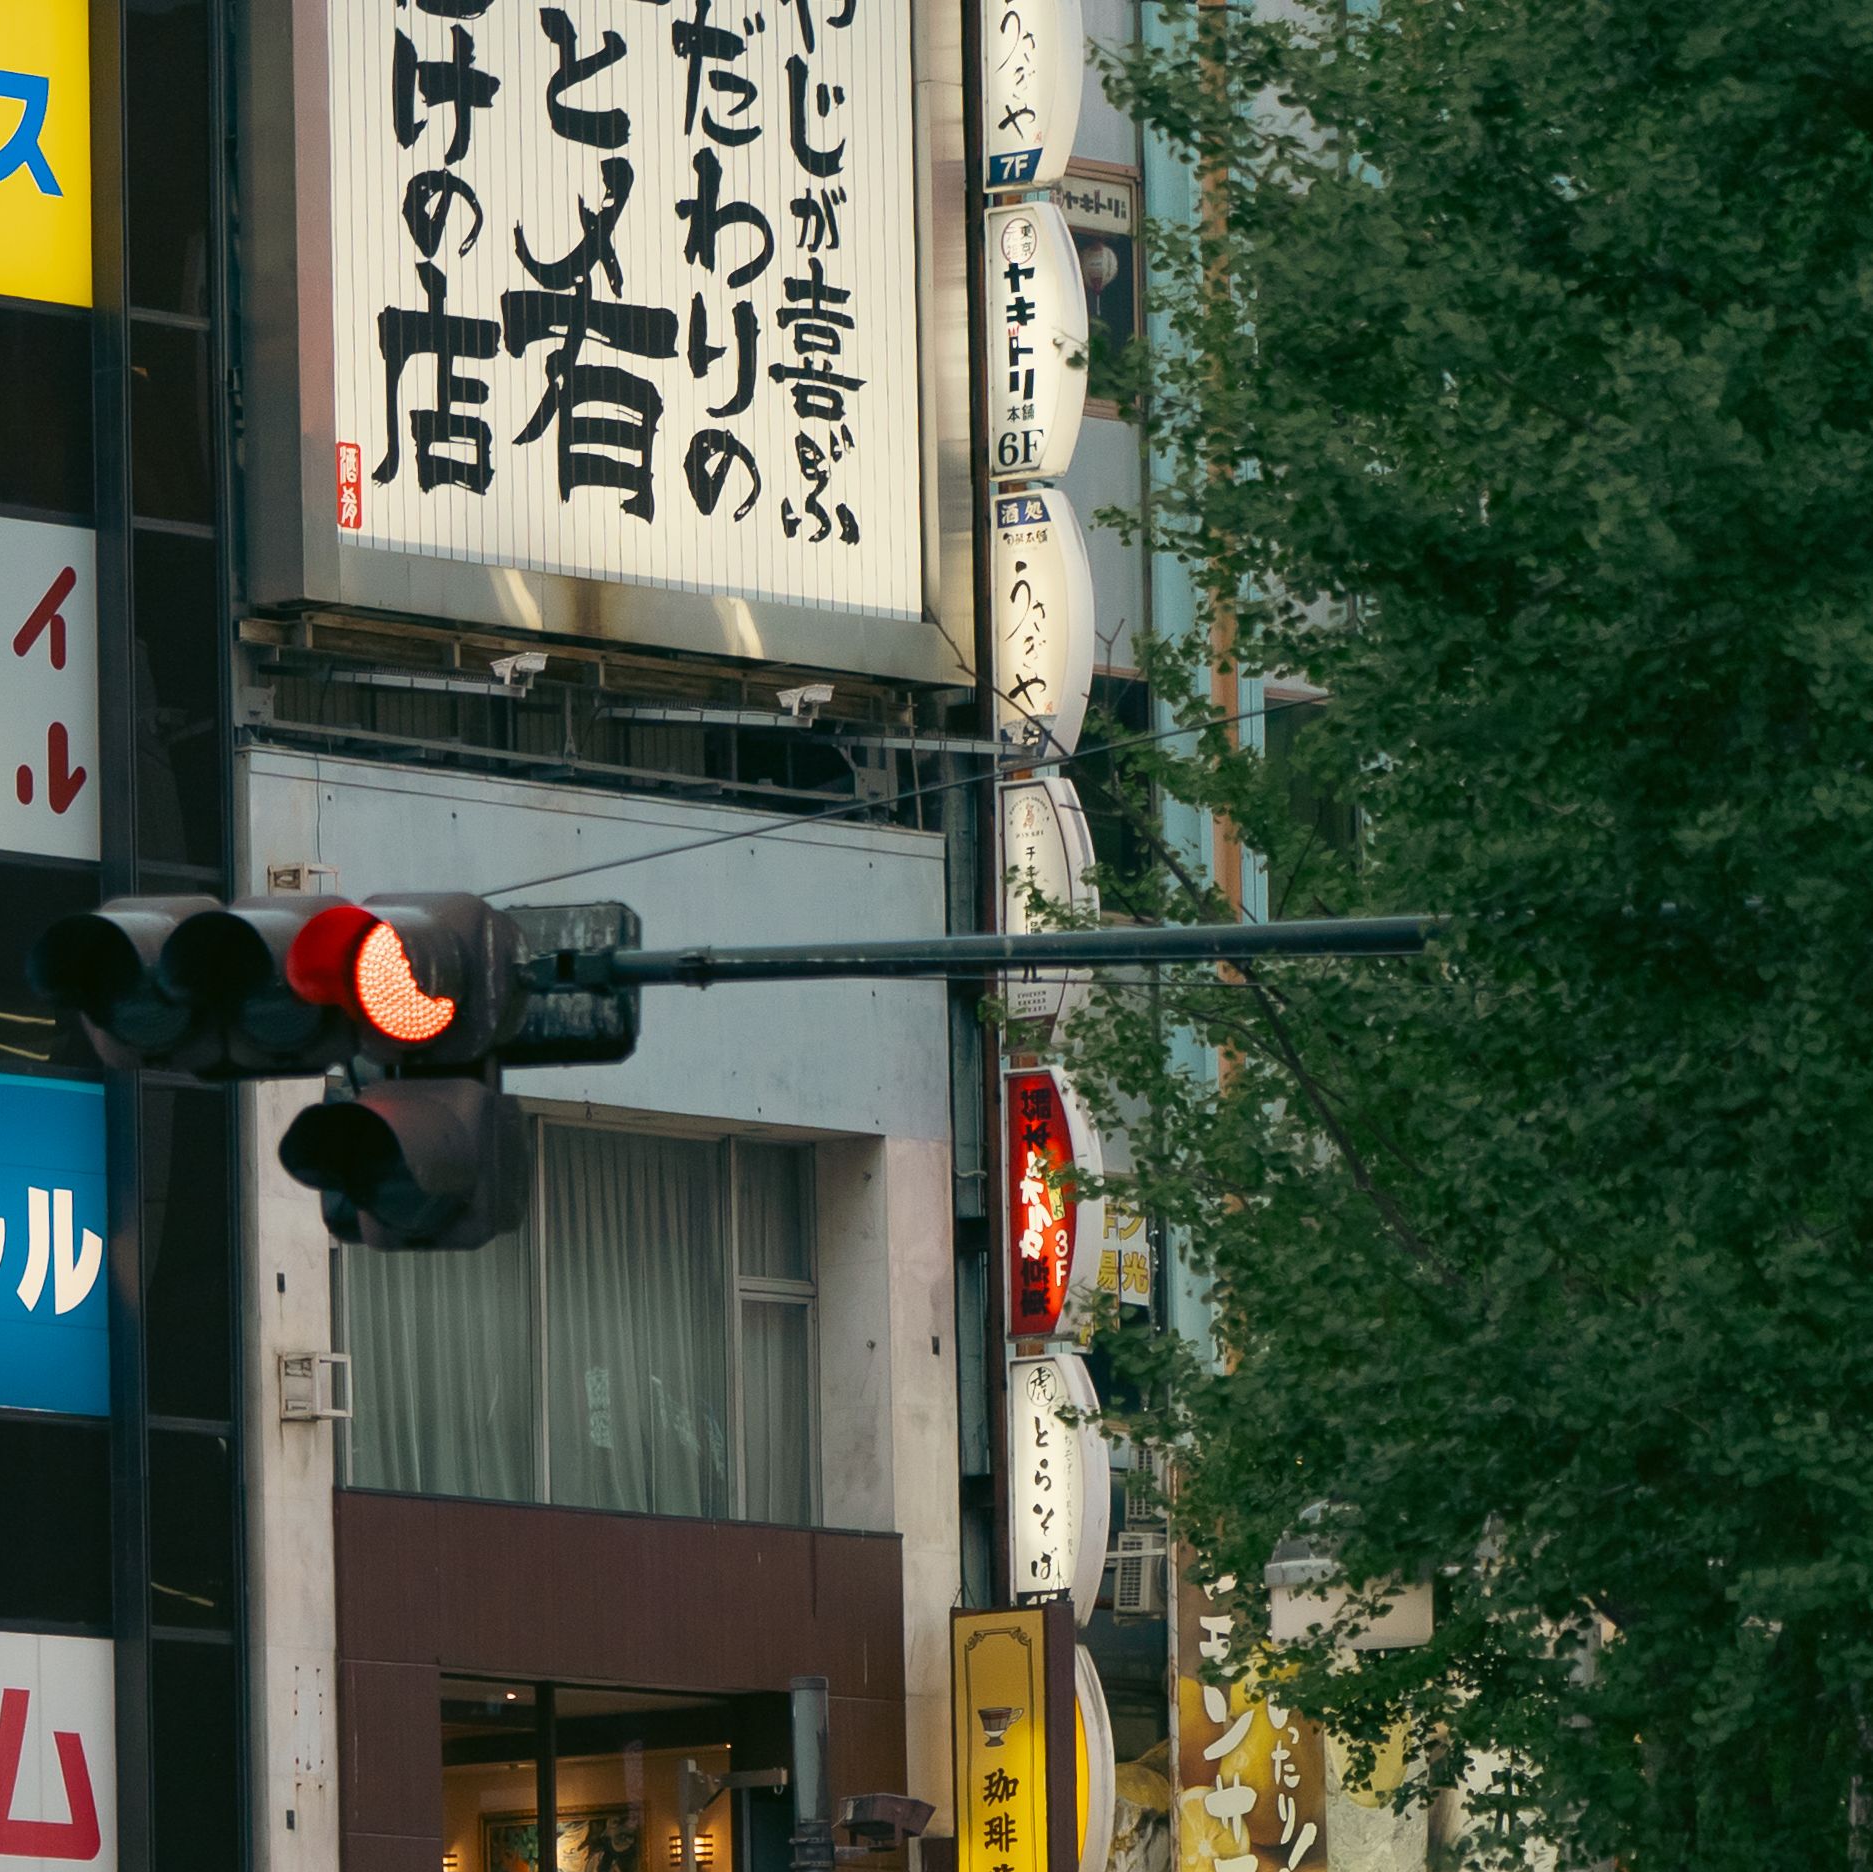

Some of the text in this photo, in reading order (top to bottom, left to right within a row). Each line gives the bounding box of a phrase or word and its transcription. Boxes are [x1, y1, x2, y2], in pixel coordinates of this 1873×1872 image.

[1000, 154, 1029, 181] 7F
[1003, 262, 1035, 400] ヤキトリ
[998, 429, 1044, 467] 6F
[1001, 500, 1044, 525] 酒処
[1030, 1415, 1057, 1581] とらそば
